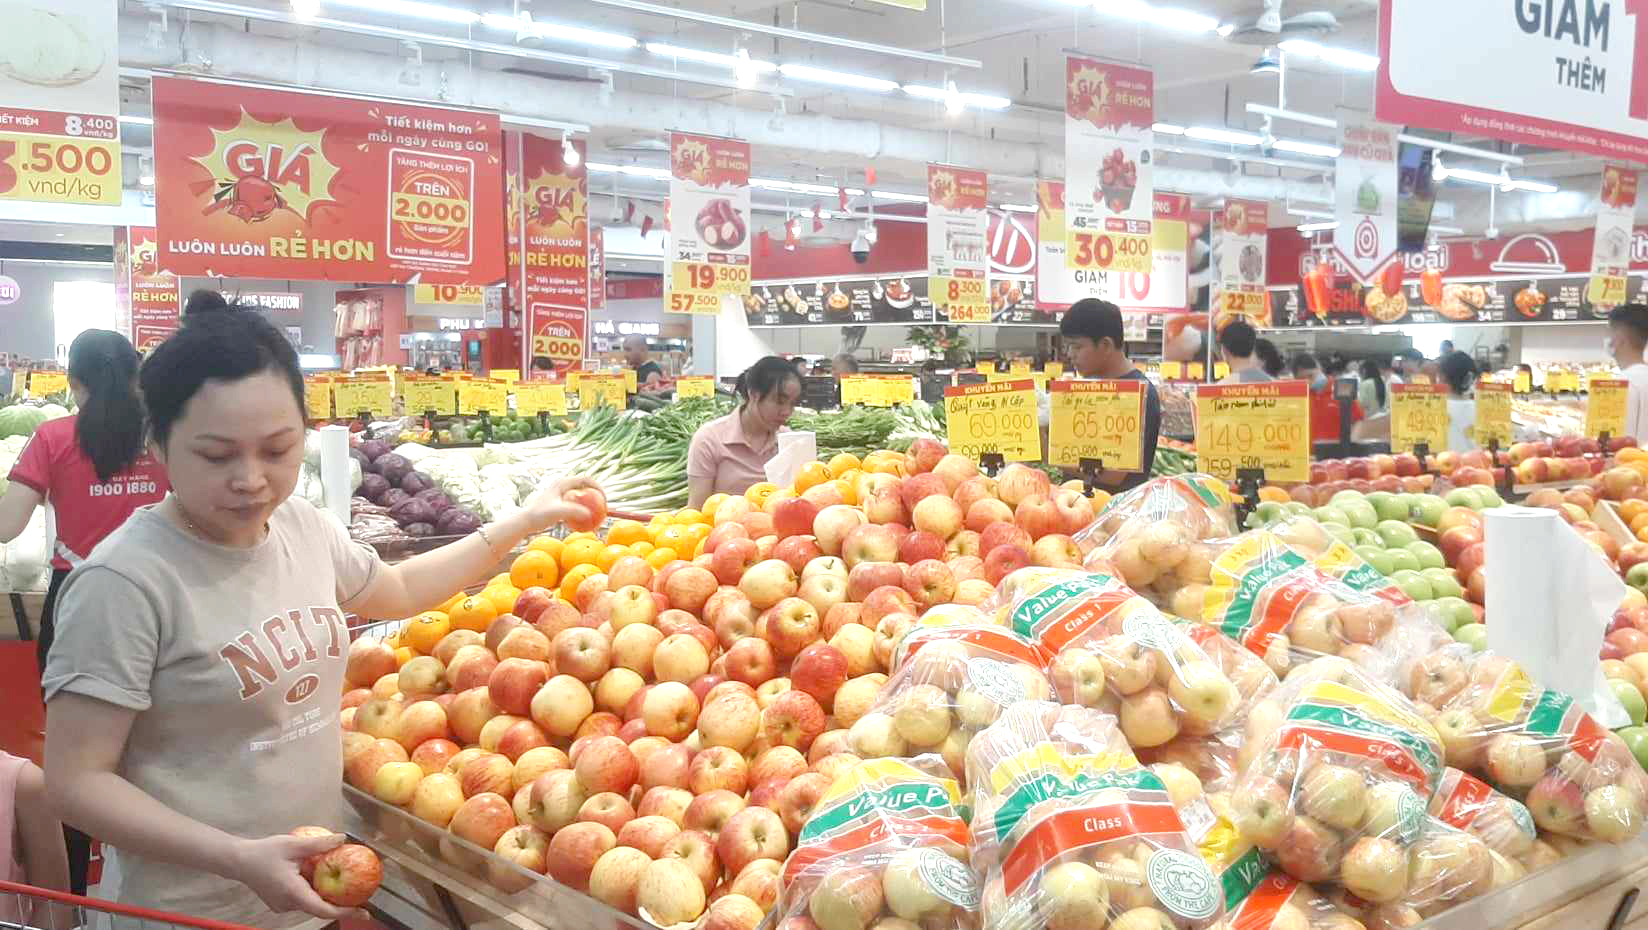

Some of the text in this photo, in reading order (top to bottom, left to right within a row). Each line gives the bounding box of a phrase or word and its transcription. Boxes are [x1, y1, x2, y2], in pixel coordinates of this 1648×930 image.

[1555, 56, 1606, 94] THÊM
[385, 115, 411, 128] Tiết
[448, 122, 472, 135] hơn
[396, 134, 428, 148] ngày
[431, 137, 462, 151] cùng
[465, 140, 488, 152] GO!
[223, 140, 317, 198] GIÁ
[28, 177, 102, 200] vnd/kg
[414, 181, 450, 197] TRÊN
[395, 198, 466, 223] 2.000
[168, 229, 374, 263] LUÔN LUÔN RẺ HƠN
[526, 247, 586, 268] RẺ HƠN
[260, 294, 300, 309] FASHION
[534, 339, 582, 357] 2.000
[89, 481, 156, 497] 1900 1880
[1018, 589, 1068, 623] Value
[1063, 610, 1095, 633] Class
[218, 606, 346, 701] NCIT
[848, 790, 917, 818] Value
[1083, 816, 1123, 834] Class
